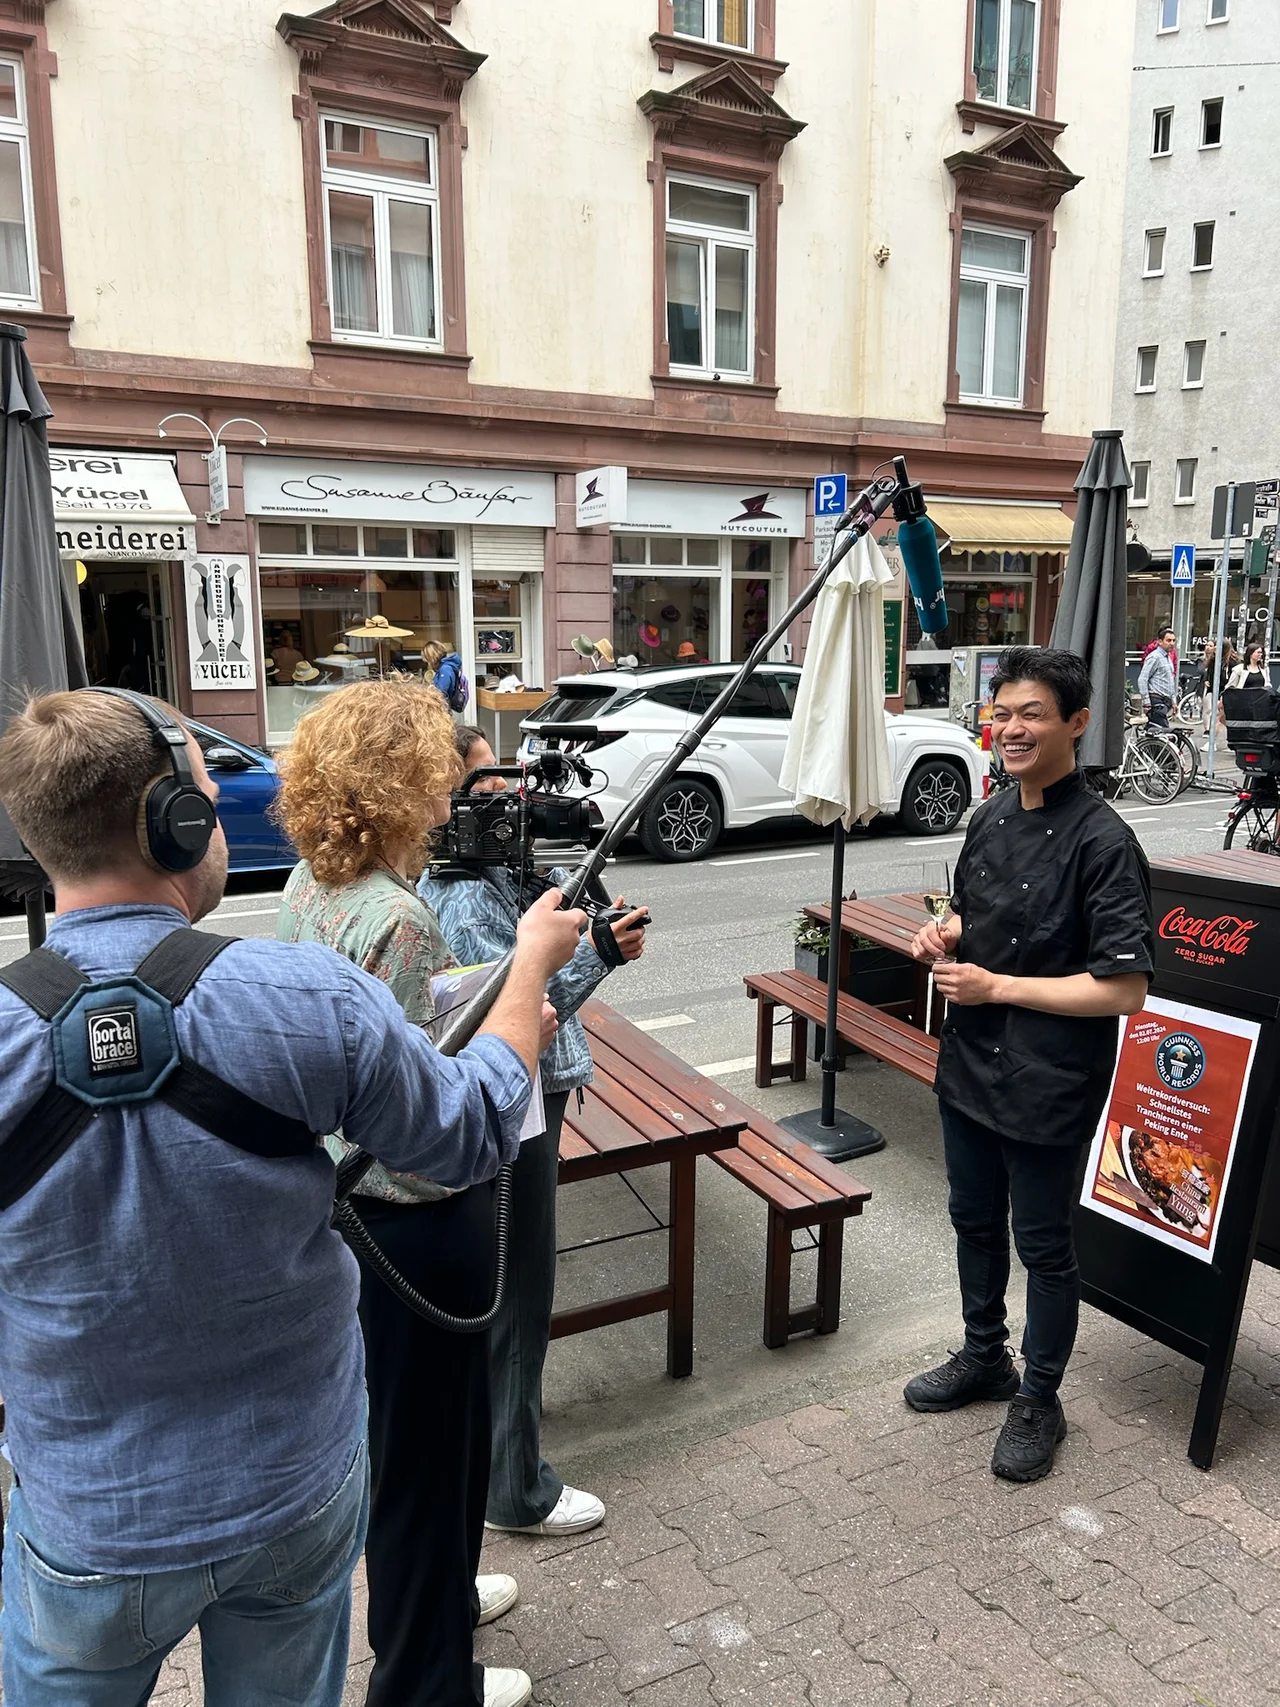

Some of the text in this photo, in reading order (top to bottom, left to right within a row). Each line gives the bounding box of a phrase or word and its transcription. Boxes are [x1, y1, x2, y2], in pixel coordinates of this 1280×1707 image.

[49, 457, 122, 474] erei
[52, 486, 148, 500] Yücel
[281, 475, 419, 500] Susanne
[820, 481, 837, 511] P
[56, 500, 94, 508] Seit
[56, 525, 187, 550] neiderei
[720, 526, 788, 534] HUTCOUTURE
[1232, 608, 1270, 622] LLO
[200, 662, 246, 678] YÜCEL
[1158, 906, 1260, 955] Coca-Cola
[1174, 948, 1226, 964] ZERO SUGAR
[93, 1019, 132, 1044] porta
[1134, 1022, 1158, 1031] Dienstag,
[94, 1042, 133, 1060] brace
[1164, 1036, 1200, 1057] GUINNESS
[1158, 1052, 1202, 1088] WORLD RECORDS
[1136, 1083, 1211, 1114] Weltrekordversuch:
[1149, 1098, 1192, 1120] Schnellstes
[1136, 1104, 1203, 1134] Tranchieren einer
[1144, 1118, 1189, 1140] Peking Ente
[1170, 1183, 1207, 1214] Restaurant
[1182, 1182, 1202, 1200] China
[1171, 1195, 1196, 1222] Yung
